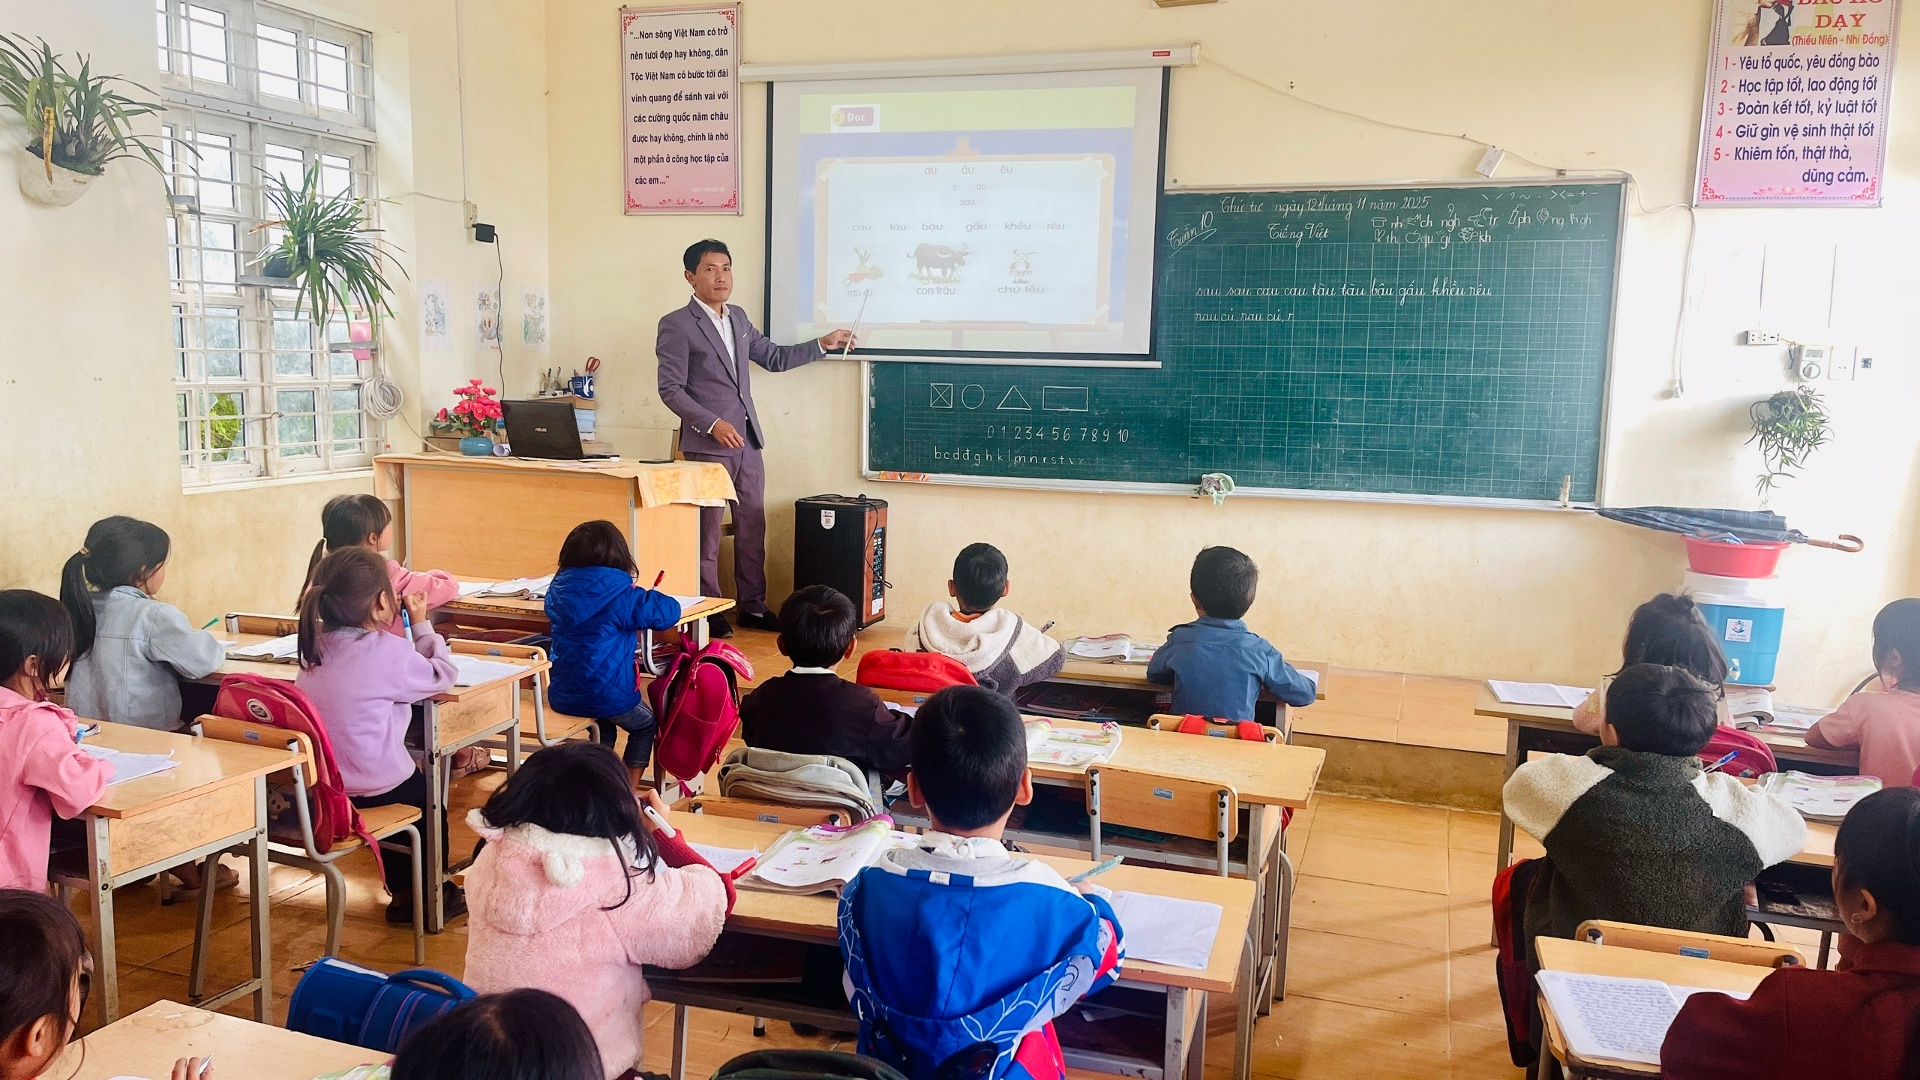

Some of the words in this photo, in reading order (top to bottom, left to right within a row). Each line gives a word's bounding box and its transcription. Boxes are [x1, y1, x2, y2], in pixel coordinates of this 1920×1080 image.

[1815, 13, 1866, 31] DẠY
[655, 30, 672, 40] sông
[674, 28, 688, 38] Việt
[690, 28, 705, 36] Nam
[708, 27, 716, 36] có
[718, 26, 728, 35] trở
[1792, 34, 1816, 46] (Thiếu
[1818, 34, 1838, 45] Niên
[1846, 34, 1860, 44] Nhi
[630, 51, 643, 60] nên
[645, 50, 658, 59] tươi
[660, 50, 672, 60] đẹp
[675, 50, 687, 60] hay
[689, 48, 713, 59] không,
[715, 48, 728, 56] dân
[1724, 56, 1728, 70] 1
[1740, 56, 1758, 69] Yêu
[1762, 52, 1772, 69] tổ
[1774, 53, 1803, 71] quốc,
[1806, 56, 1825, 70] yêu
[1829, 52, 1855, 70] đồng
[1858, 53, 1879, 67] bào
[630, 72, 643, 82] Tộc
[645, 72, 658, 82] Việt
[660, 72, 675, 80] Nam
[678, 71, 686, 79] có
[688, 70, 704, 78] bước
[706, 69, 716, 78] tới
[718, 69, 728, 77] đài
[1721, 80, 1727, 93] 2
[1739, 79, 1761, 95] Học
[1764, 79, 1783, 95] tập
[1787, 76, 1804, 93] tốt,
[1808, 78, 1825, 91] lao
[1829, 77, 1859, 94] động
[1862, 75, 1877, 90] tốt
[632, 94, 646, 102] vinh
[649, 94, 671, 103] quang
[674, 91, 682, 101] để
[685, 92, 702, 100] sánh
[704, 92, 715, 100] vai
[718, 91, 728, 99] với
[1718, 102, 1725, 115] 3
[1737, 101, 1769, 114] Đoàn
[1773, 99, 1792, 114] kết
[1796, 99, 1813, 116] tốt,
[1818, 98, 1832, 116] kỷ
[1836, 100, 1858, 116] luật
[1862, 98, 1877, 113] tốt
[634, 114, 646, 122] các
[648, 113, 670, 124] cường
[673, 112, 690, 123] quốc
[693, 112, 708, 121] năm
[711, 112, 728, 120] châu
[1716, 125, 1723, 138] 4
[1736, 124, 1758, 138] Giữ
[1760, 124, 1780, 140] gìn
[1784, 124, 1799, 140] vệ
[1802, 124, 1826, 138] sinh
[1831, 123, 1854, 140] thật
[1858, 121, 1874, 137] tốt
[632, 134, 648, 144] được
[650, 134, 661, 144] hay
[664, 133, 686, 143] không,
[708, 133, 713, 141] là
[634, 155, 646, 165] một
[672, 155, 688, 164] công
[690, 155, 702, 164] học
[704, 154, 715, 164] tập
[717, 153, 728, 162] của
[1714, 148, 1720, 160] 5
[1735, 147, 1772, 160] Khiêm
[1776, 144, 1798, 161] tốn,
[1802, 146, 1826, 162] thật
[1830, 145, 1852, 161] thà,
[924, 167, 937, 175] au
[1802, 169, 1833, 186] dũng
[1838, 166, 1869, 182] cảm.
[635, 176, 646, 184] các
[1200, 211, 1214, 228] 10
[917, 287, 934, 295] con
[937, 286, 956, 295] trâu
